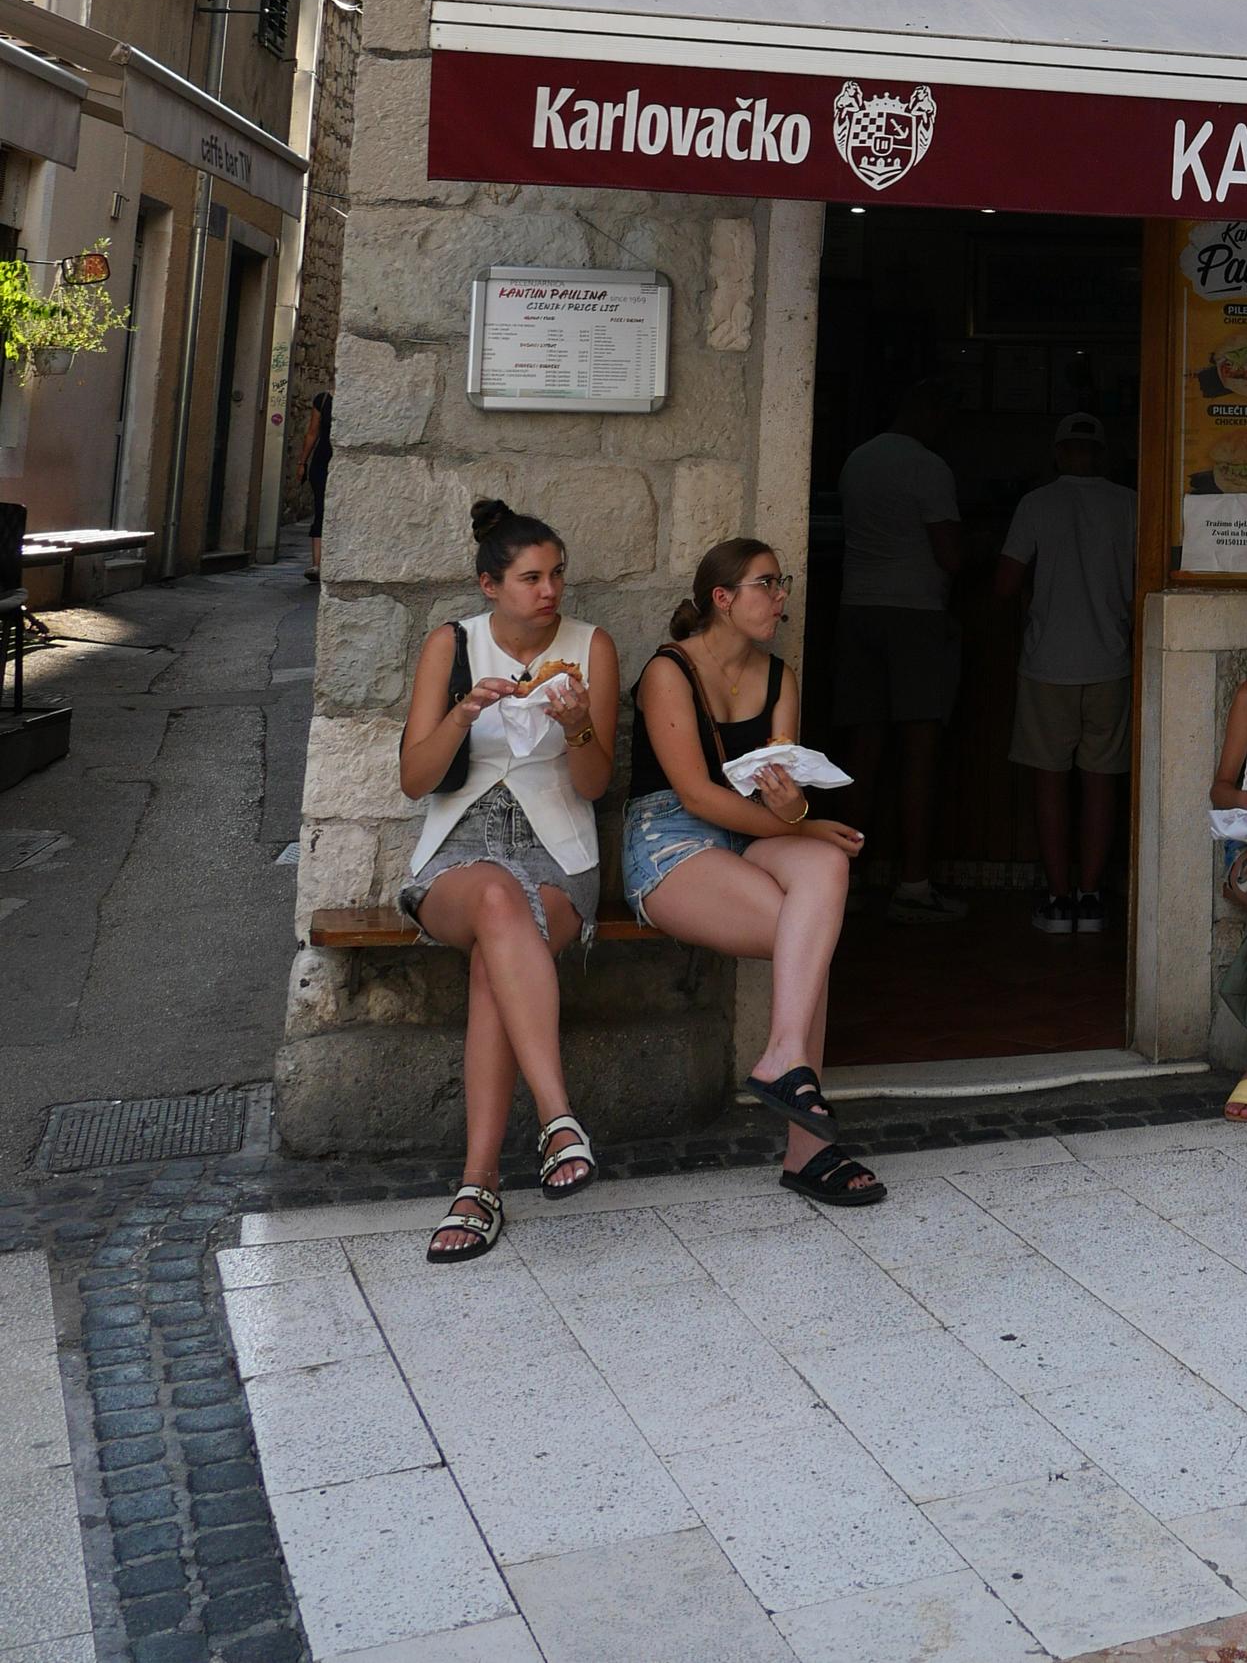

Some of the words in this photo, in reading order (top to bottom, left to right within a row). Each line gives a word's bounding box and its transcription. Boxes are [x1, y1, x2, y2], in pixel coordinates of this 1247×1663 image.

[532, 85, 811, 164] Karlovačko
[224, 141, 239, 179] bar
[498, 287, 548, 299] KANTUN
[550, 288, 608, 301] PAULINA
[567, 303, 599, 312] PRICE
[599, 304, 620, 312] LIST
[1211, 529, 1230, 537] Zvati
